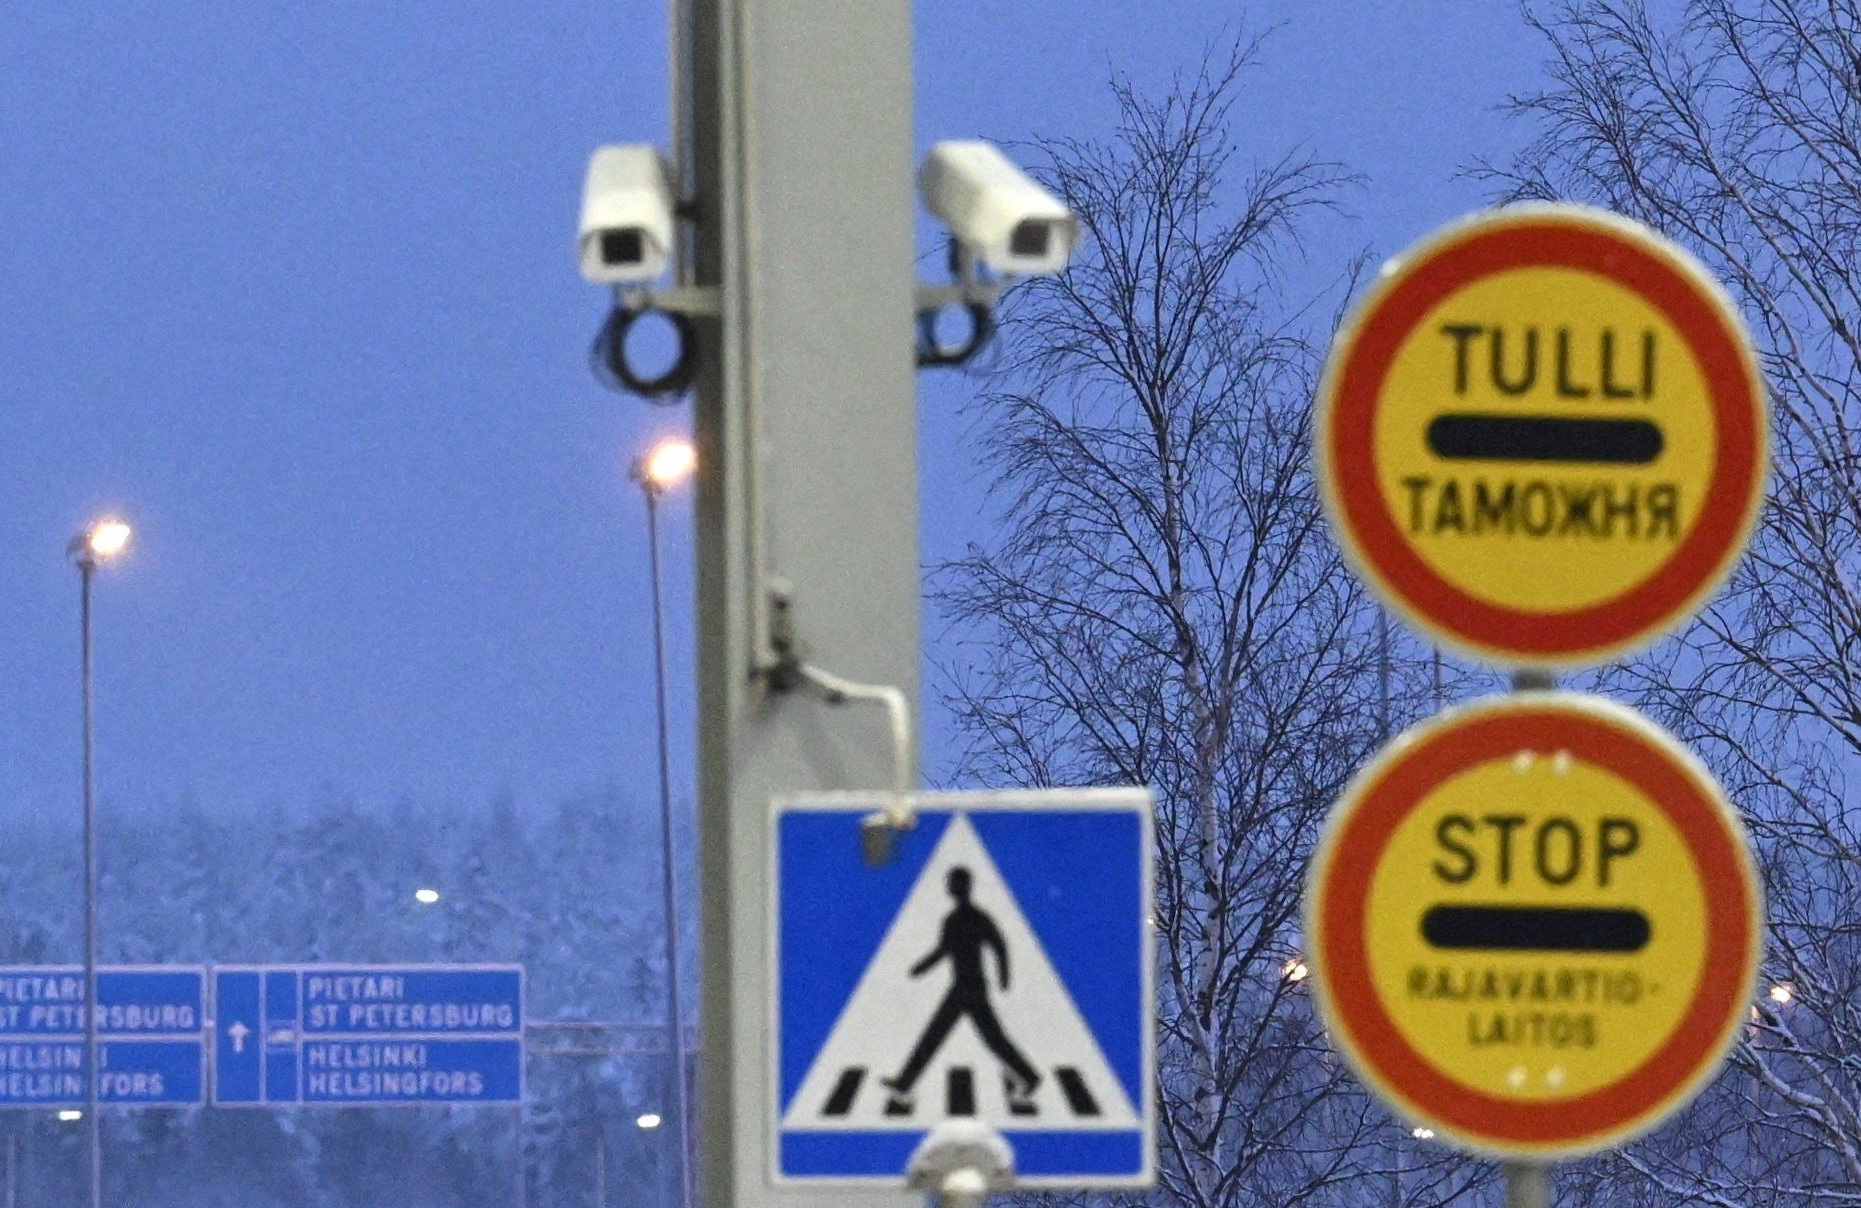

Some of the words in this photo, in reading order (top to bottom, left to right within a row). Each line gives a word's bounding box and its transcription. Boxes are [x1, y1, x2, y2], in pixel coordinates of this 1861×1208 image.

[1441, 324, 1656, 400] TULLI
[1401, 475, 1680, 541] ТАМОЖНЯ
[1432, 813, 1642, 888] STOP
[309, 976, 405, 1001] PIETARI
[29, 1004, 195, 1029] PETERSBURG
[310, 1003, 338, 1028] ST
[349, 1003, 514, 1028] PETERSBURG
[1467, 1011, 1595, 1049] LAITOS
[308, 1044, 427, 1069] HELSINKI
[308, 1071, 484, 1096] HELSINGFORS
